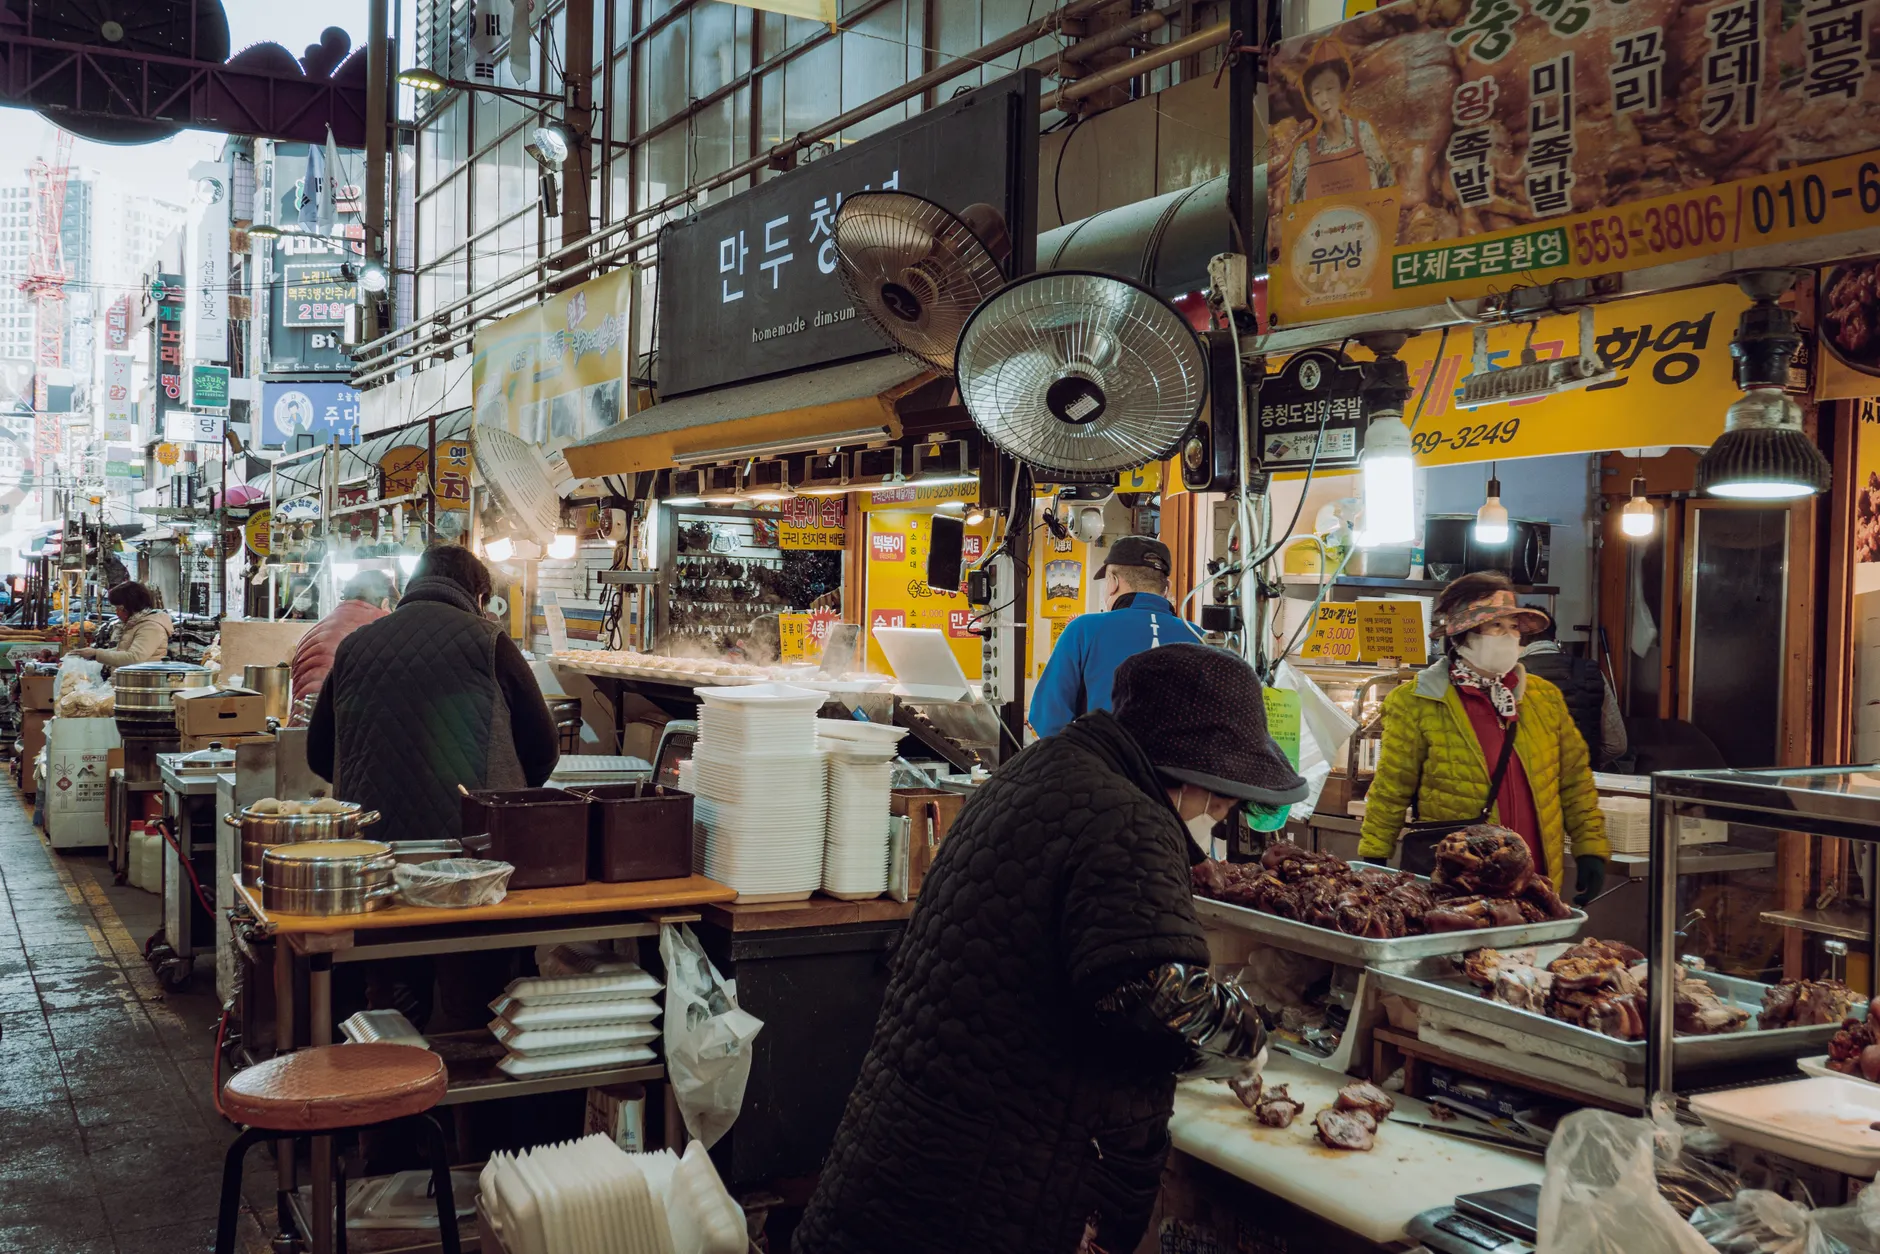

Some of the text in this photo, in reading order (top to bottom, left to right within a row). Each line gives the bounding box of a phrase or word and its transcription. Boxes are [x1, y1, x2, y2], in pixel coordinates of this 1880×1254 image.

[1611, 30, 1661, 112] 꼬리
[1703, 2, 1759, 131] 껍데기
[1527, 55, 1574, 214] 미니족발
[1309, 239, 1362, 275] 우수상
[1396, 230, 1563, 285] 단체주문환영
[298, 303, 345, 320] 2만원
[752, 307, 856, 343] homemade dimsum
[1586, 311, 1716, 392] 환영
[782, 497, 819, 528] 떡볶이
[782, 532, 800, 546] 구리
[802, 532, 827, 546] 전지역
[874, 534, 904, 553] 떡볶이
[1322, 643, 1352, 656] 5,000
[1326, 627, 1355, 641] 3,000
